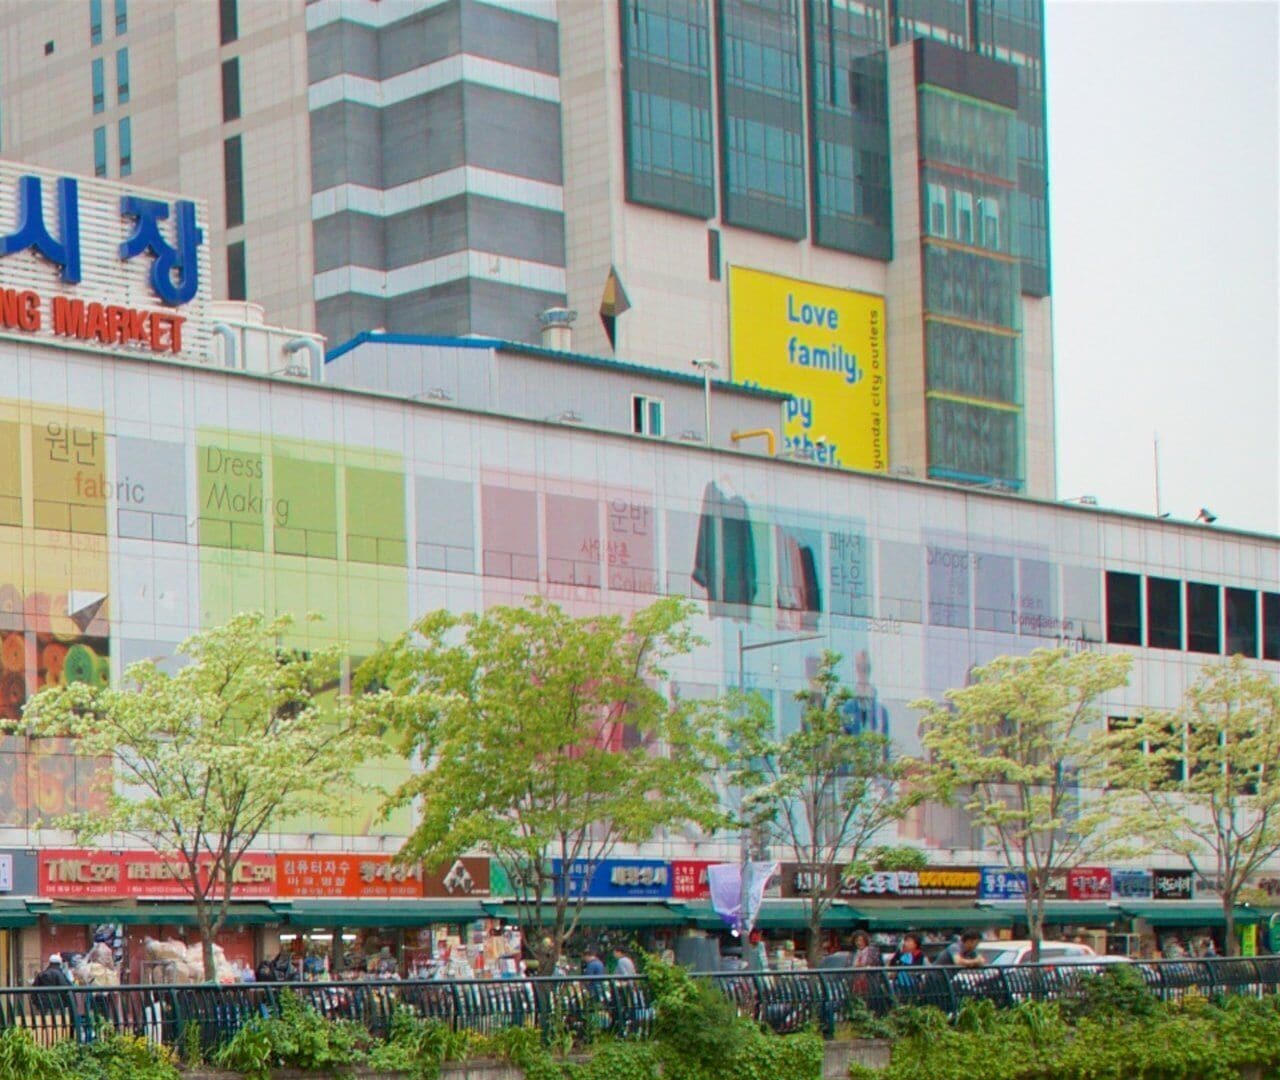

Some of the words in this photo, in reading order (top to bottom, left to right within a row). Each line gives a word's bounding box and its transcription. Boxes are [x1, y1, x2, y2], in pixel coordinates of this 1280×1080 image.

[53, 296, 186, 353] MARKET
[787, 294, 839, 330] Love
[788, 337, 864, 383] family,
[45, 422, 99, 467] 원단
[207, 445, 264, 480] Dress
[73, 474, 146, 505] fabric
[207, 483, 291, 527] Making
